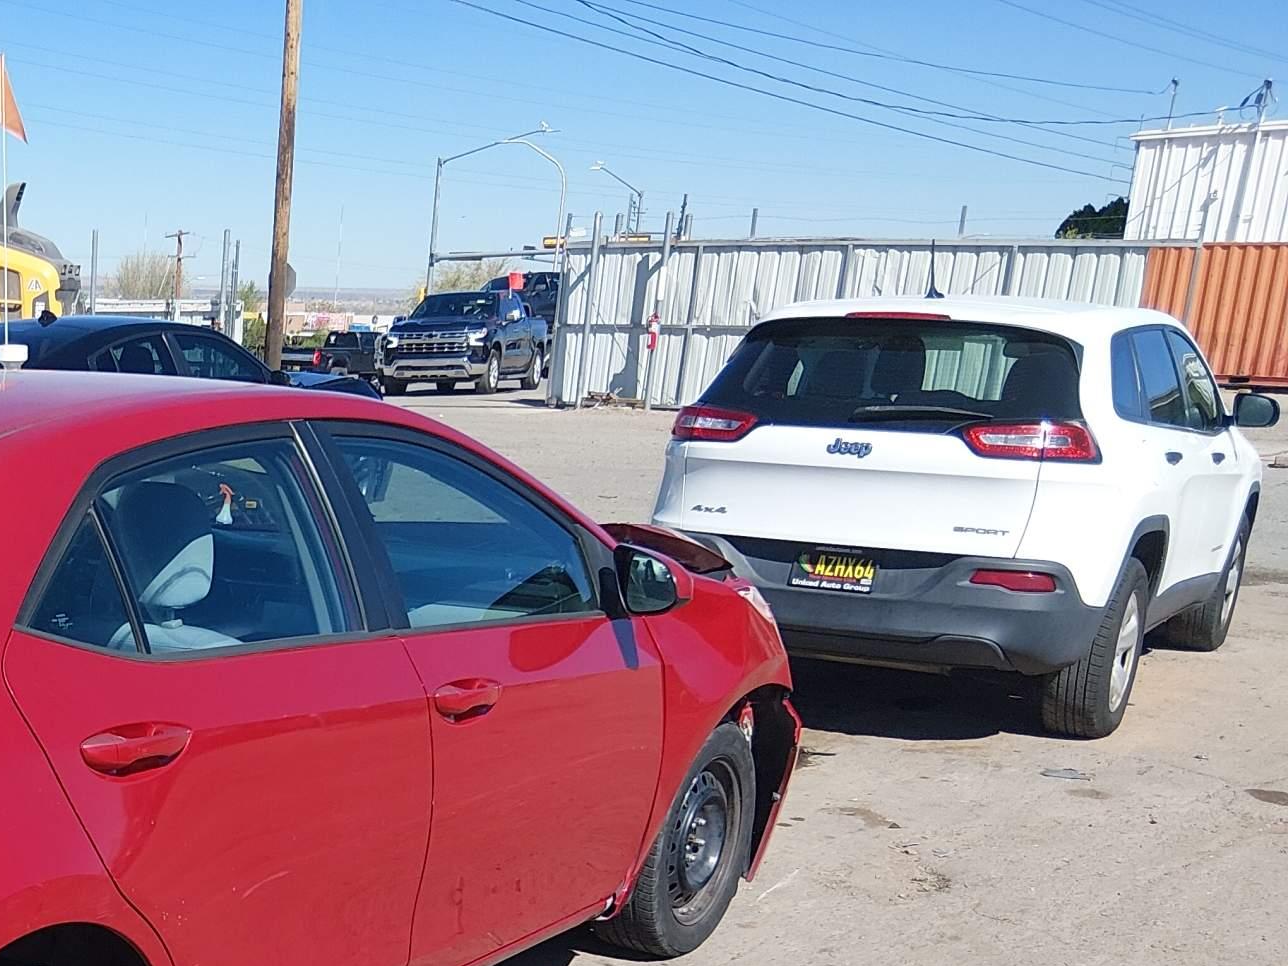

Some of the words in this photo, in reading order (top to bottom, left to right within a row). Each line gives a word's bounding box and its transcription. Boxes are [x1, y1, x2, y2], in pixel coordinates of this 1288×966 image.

[826, 438, 873, 458] Jeep
[690, 504, 728, 514] 4x4
[953, 526, 1010, 536] SPORT
[815, 555, 874, 580] AZHX64
[820, 581, 842, 589] Auto
[843, 583, 871, 592] Group
